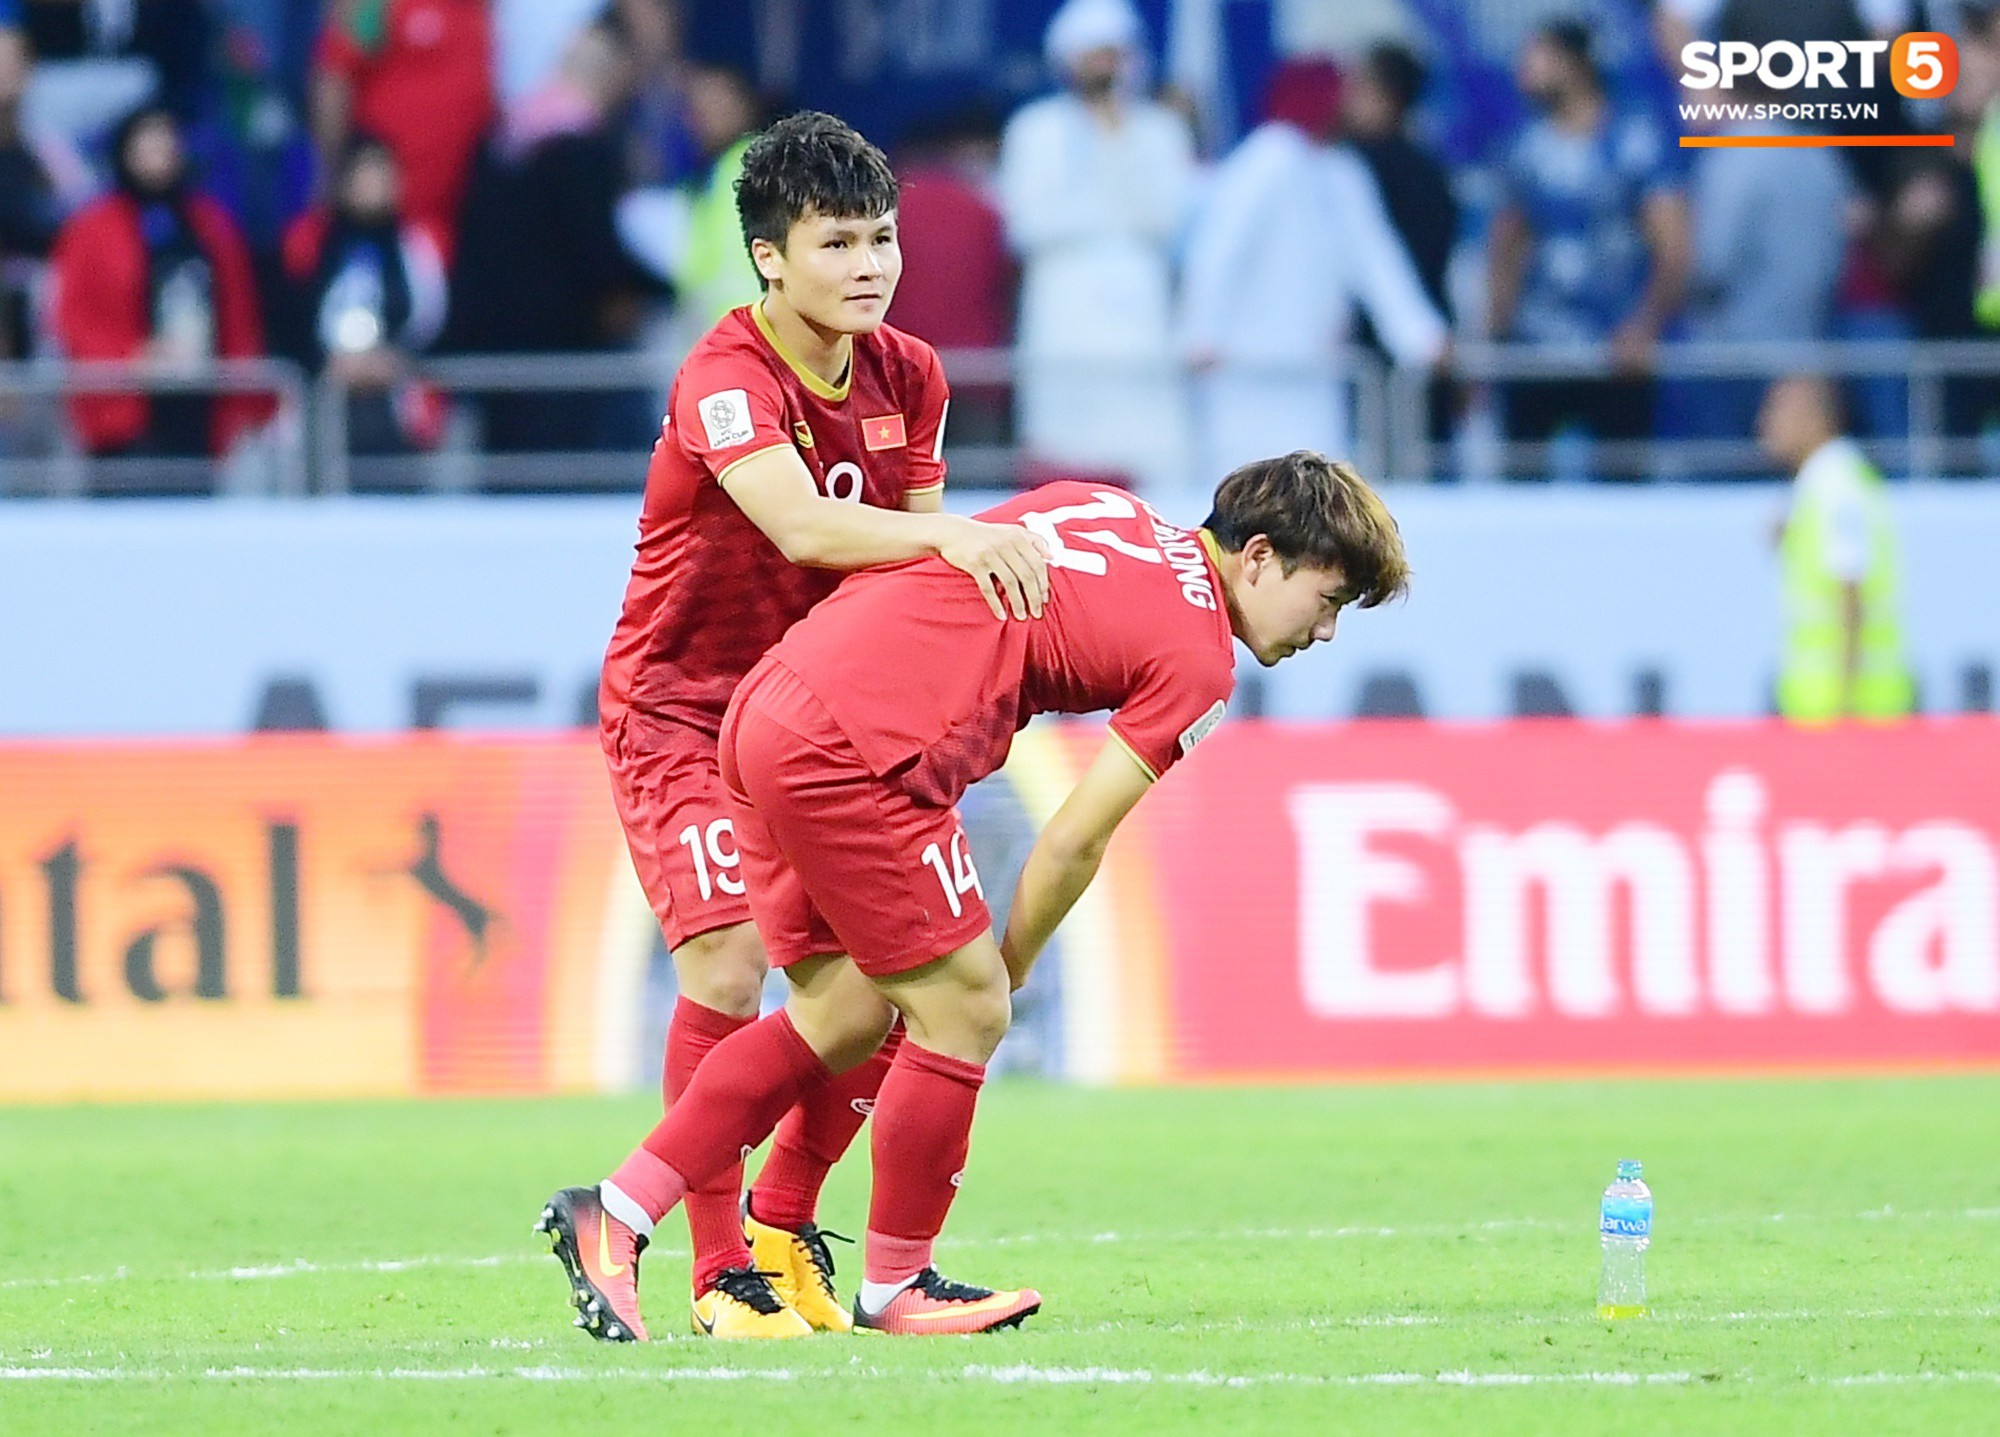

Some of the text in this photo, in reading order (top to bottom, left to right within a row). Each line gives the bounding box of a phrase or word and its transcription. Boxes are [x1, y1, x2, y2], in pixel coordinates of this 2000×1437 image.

[0, 822, 305, 1004] tal
[679, 818, 746, 900] 19
[921, 833, 984, 918] 14
[1288, 770, 2000, 1016] Emira
